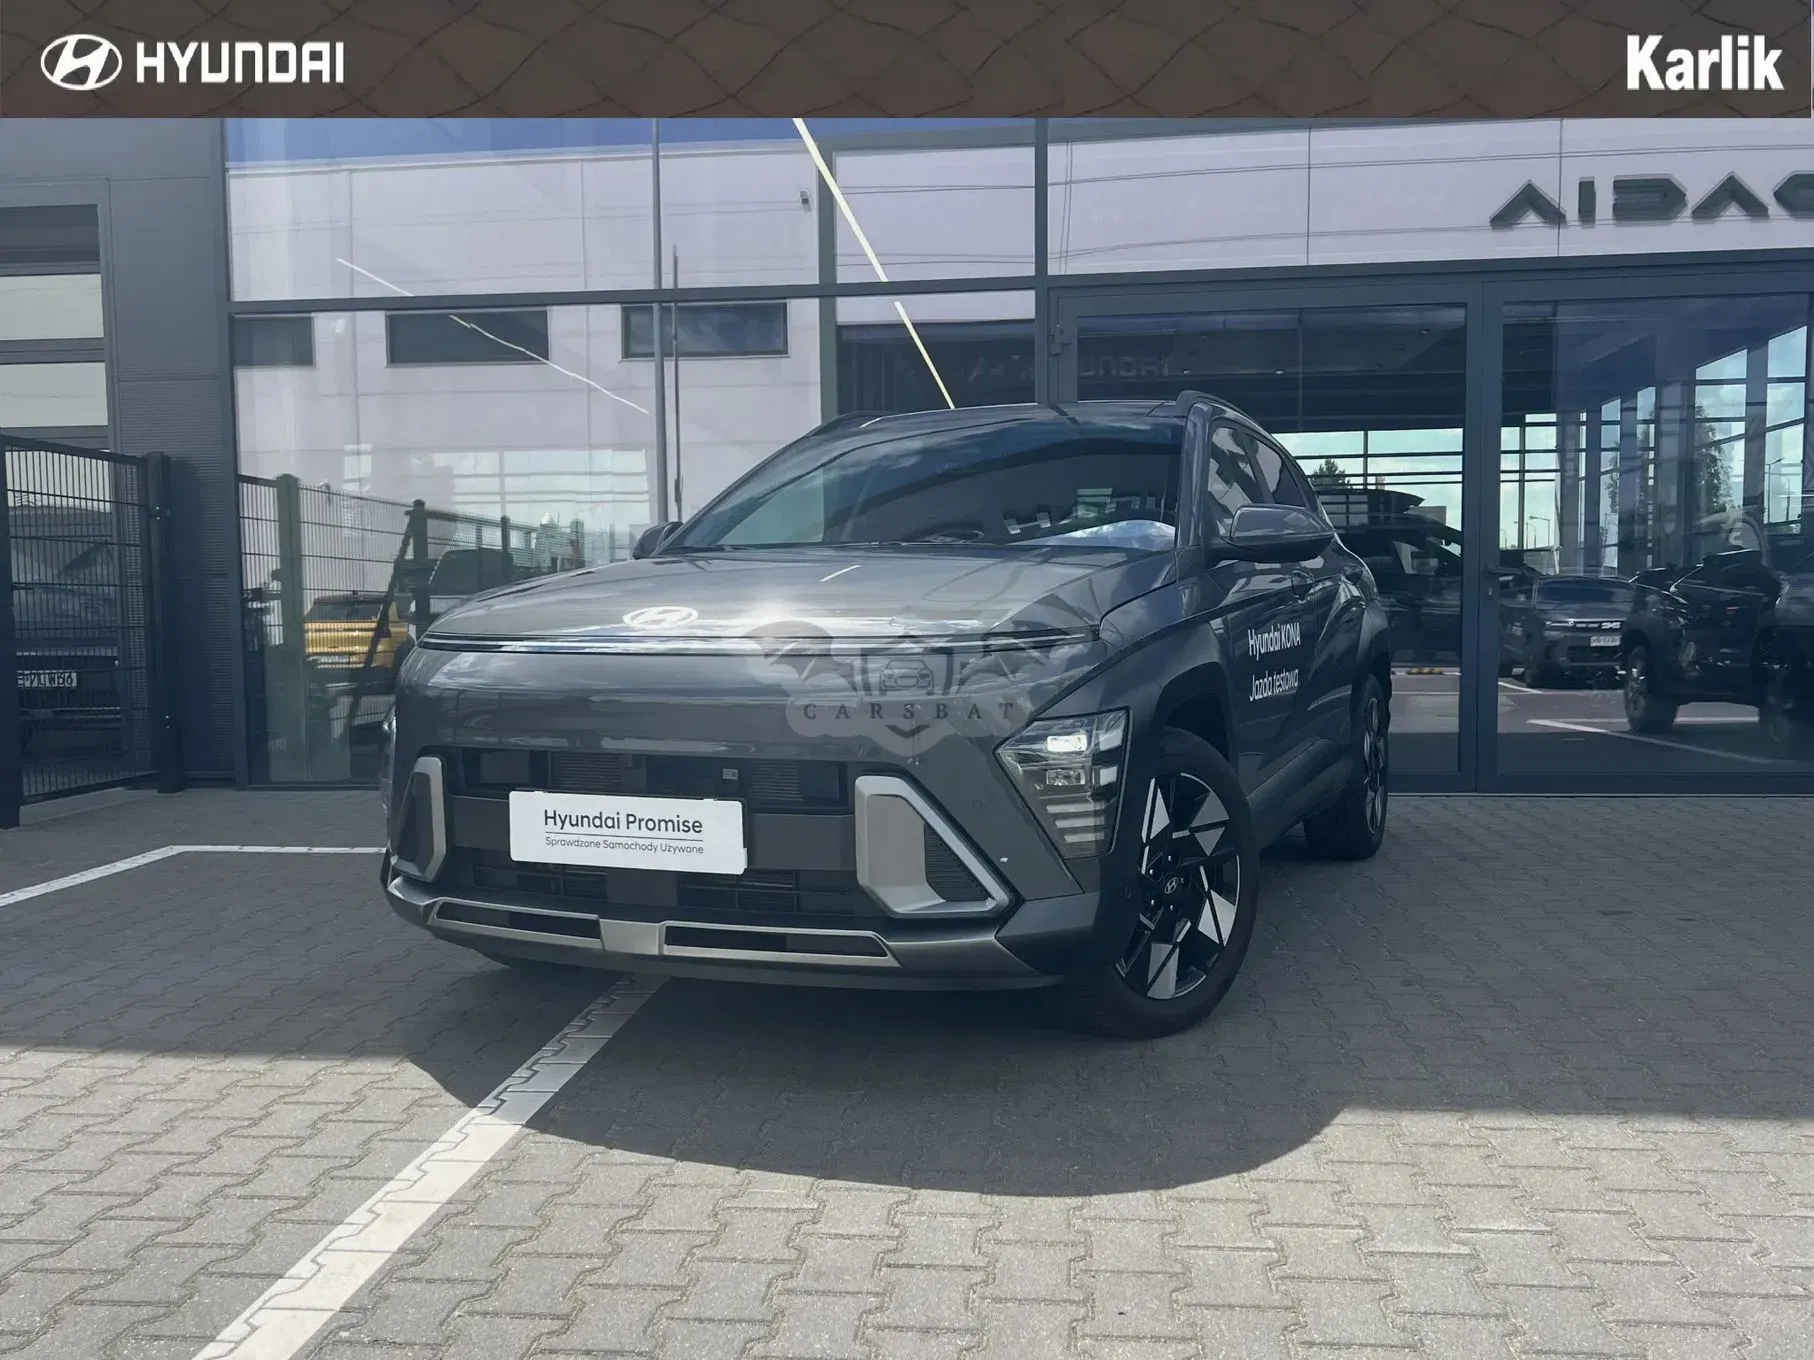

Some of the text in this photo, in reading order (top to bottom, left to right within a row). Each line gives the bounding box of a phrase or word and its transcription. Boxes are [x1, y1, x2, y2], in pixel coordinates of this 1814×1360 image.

[1248, 622, 1301, 661] Hyundai KONA
[1249, 668, 1299, 702] Jazda testowa
[544, 809, 704, 834] Hyundai Promise
[545, 836, 601, 848] Sprawdzone
[602, 839, 659, 854] Samochody
